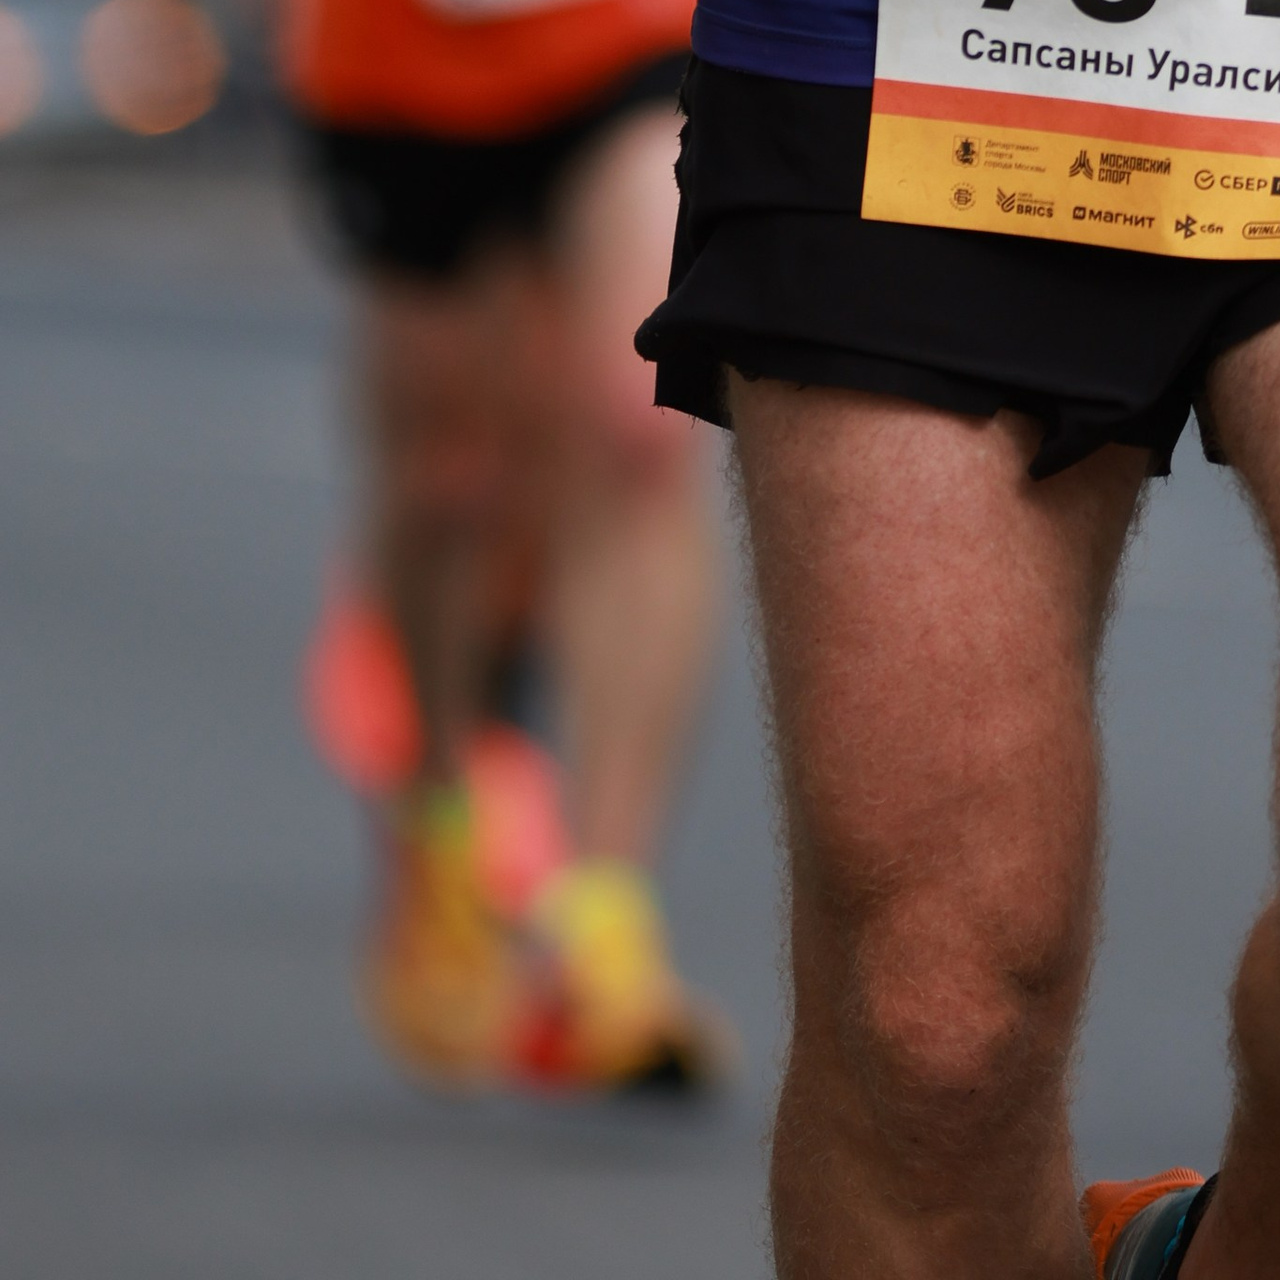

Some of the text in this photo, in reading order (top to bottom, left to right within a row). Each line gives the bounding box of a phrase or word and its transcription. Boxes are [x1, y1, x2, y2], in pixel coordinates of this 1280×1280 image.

[960, 28, 1134, 78] Сапсаны
[1100, 152, 1172, 176] МОСКОВСКИЙ
[1098, 168, 1132, 186] СПОРТ
[1220, 175, 1268, 192] СБЕР
[1016, 203, 1054, 219] BRICS
